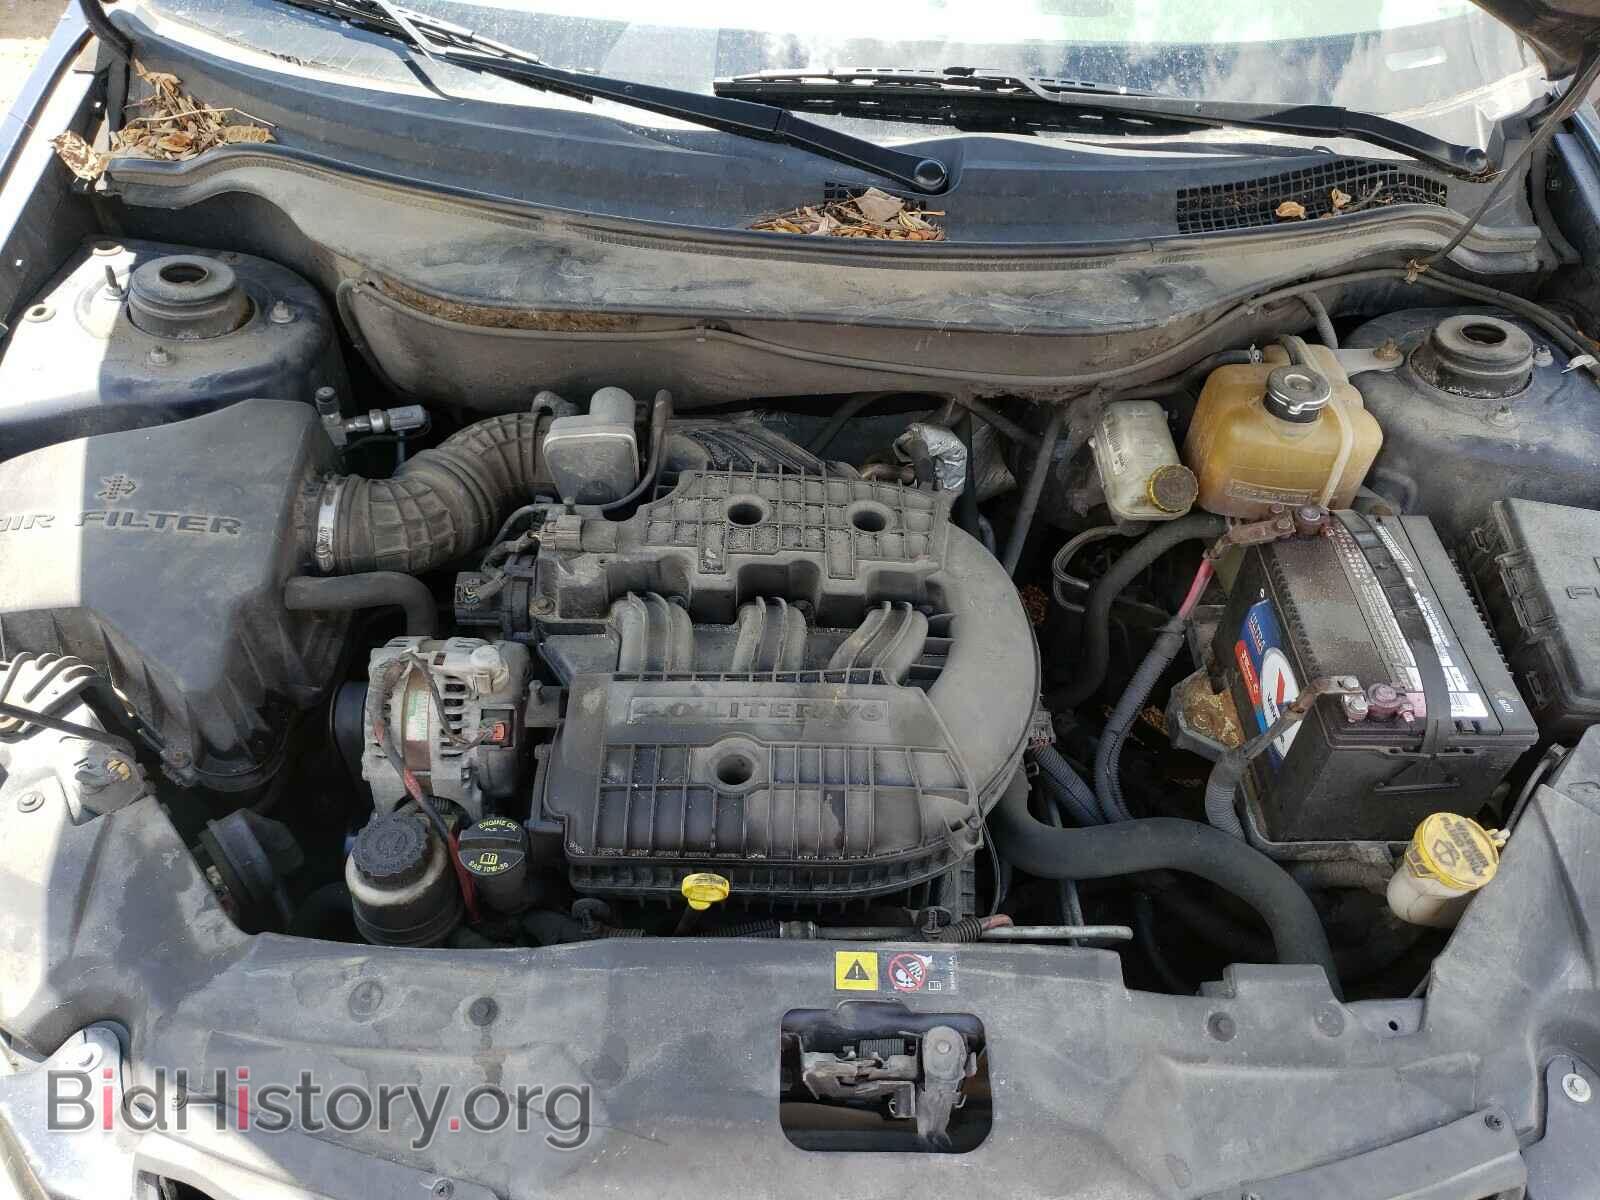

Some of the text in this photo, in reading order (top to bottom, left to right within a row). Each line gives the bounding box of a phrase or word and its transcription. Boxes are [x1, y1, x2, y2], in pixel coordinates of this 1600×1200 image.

[75, 511, 242, 535] FILTER
[704, 702, 820, 720] LITER
[478, 819, 506, 829] ENGINE
[506, 822, 519, 832] OIL
